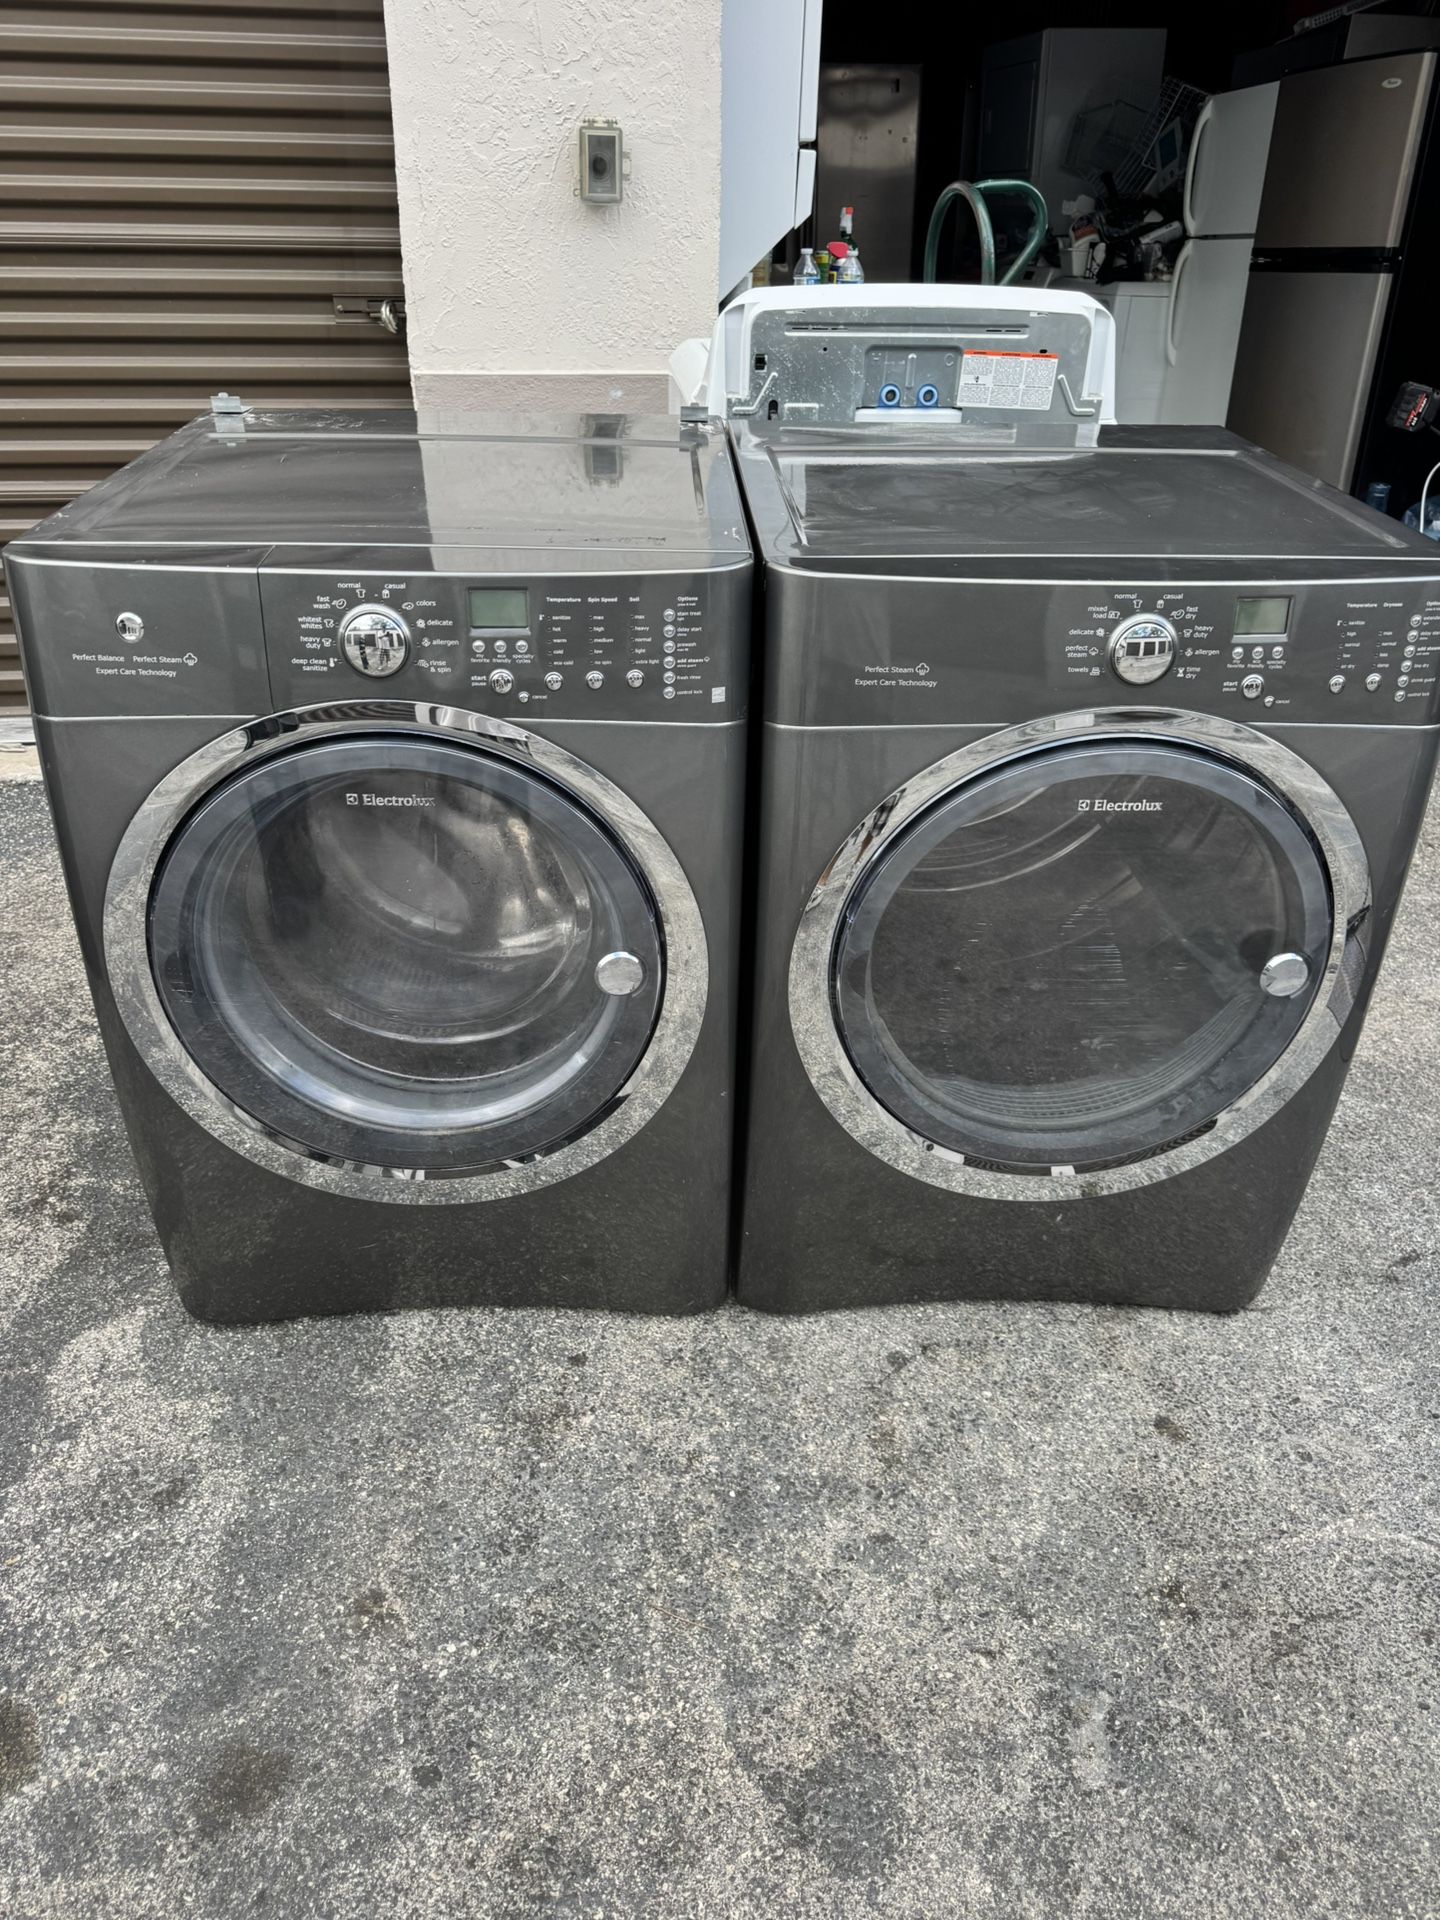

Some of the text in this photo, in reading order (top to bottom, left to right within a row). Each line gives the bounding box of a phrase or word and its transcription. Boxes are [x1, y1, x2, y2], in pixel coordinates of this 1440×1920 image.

[306, 642, 321, 650] duty
[432, 639, 459, 647] allergen
[1194, 648, 1220, 656] allergen
[72, 653, 96, 661] Perfect
[97, 654, 125, 662] Balance
[158, 656, 183, 664] Steam
[95, 667, 177, 678] Expert Care Technology
[864, 665, 889, 673] Perfect
[854, 678, 938, 688] Expert Care Technology
[361, 793, 436, 807] Electrolux
[1094, 799, 1163, 811] Electrolux
